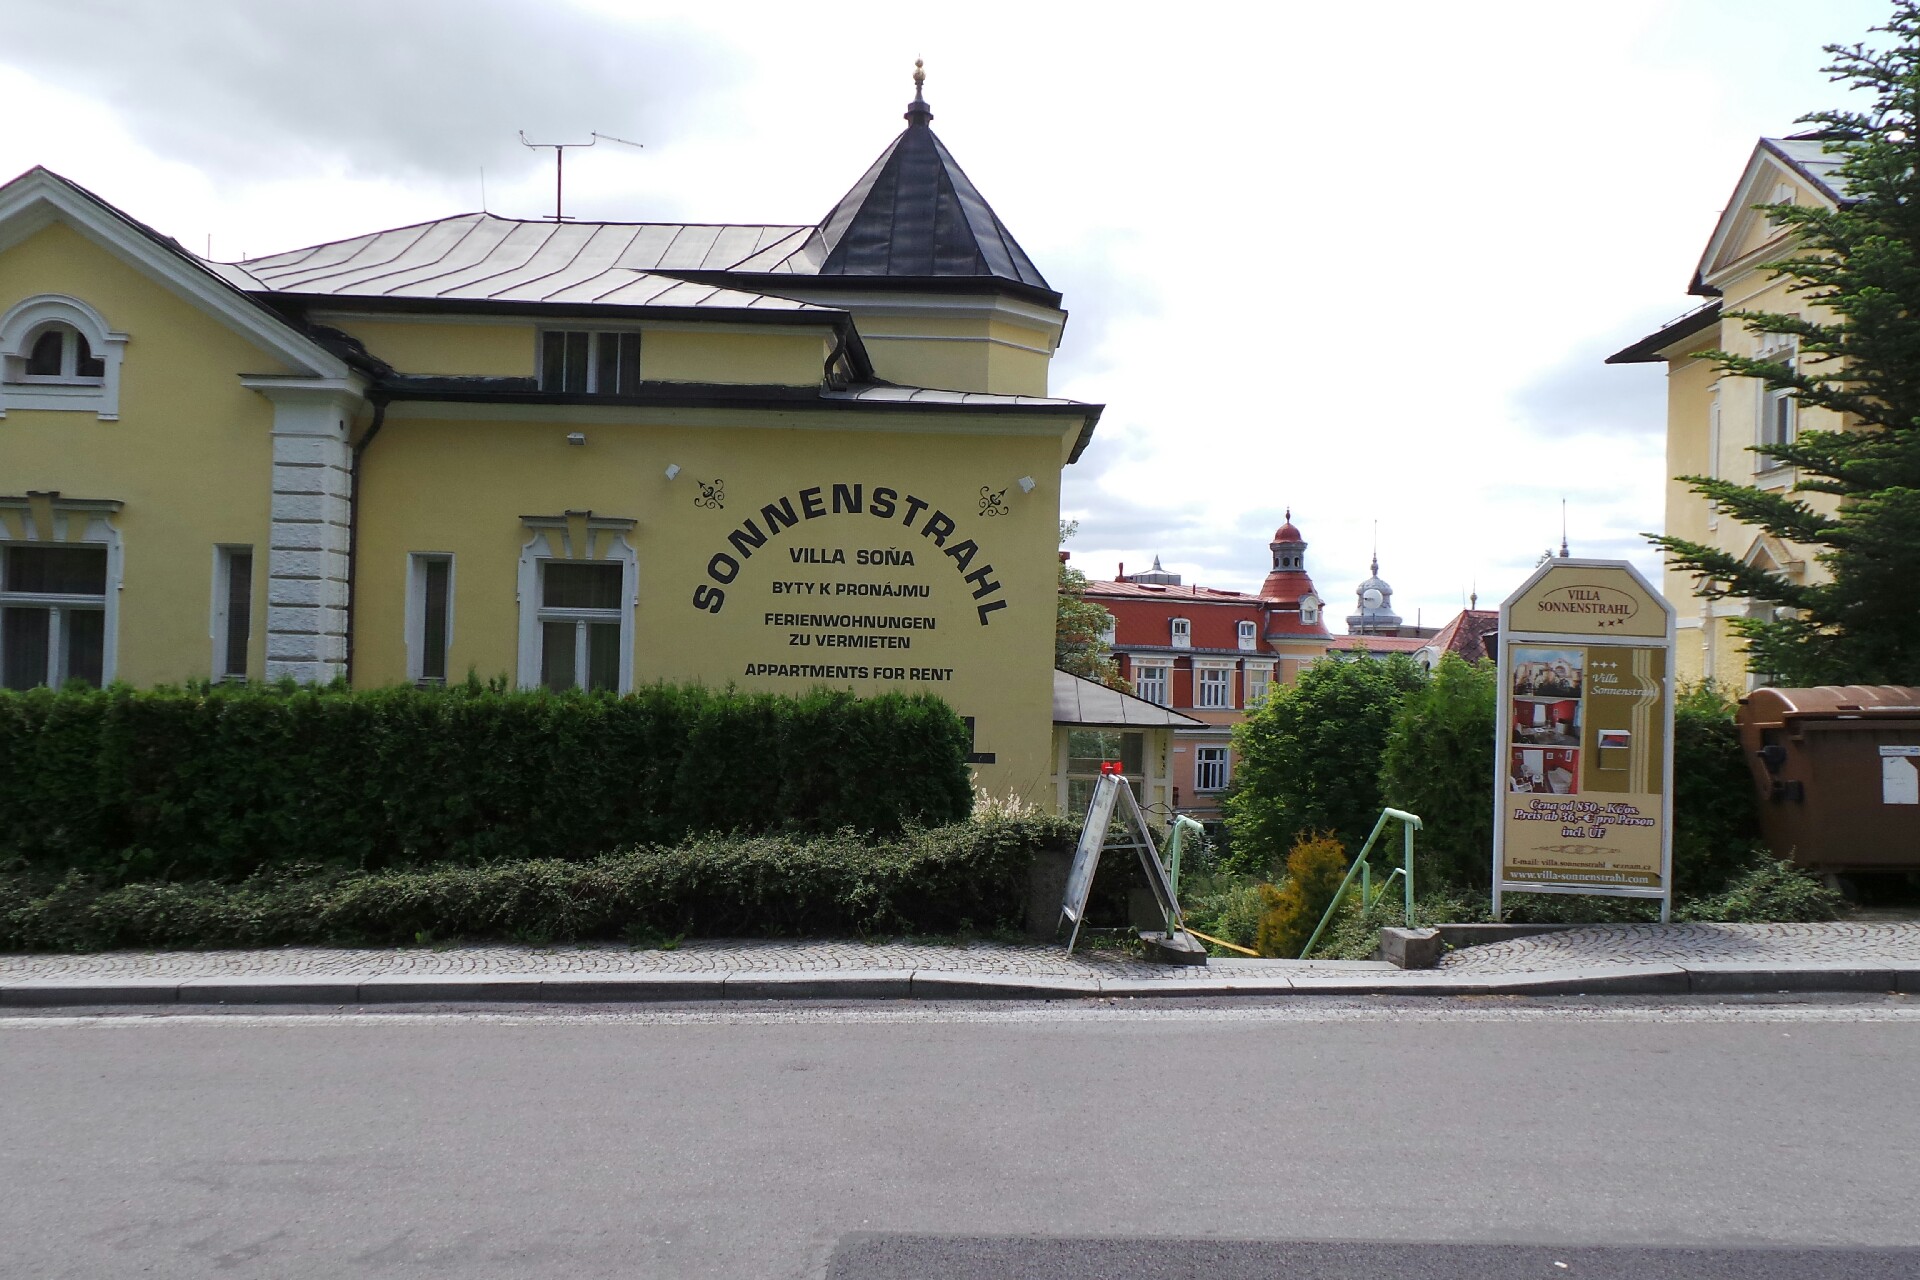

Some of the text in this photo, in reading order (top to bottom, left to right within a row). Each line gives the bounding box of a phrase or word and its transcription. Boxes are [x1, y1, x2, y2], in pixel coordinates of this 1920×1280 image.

[693, 484, 1007, 625] SONNENSTRAHL
[790, 546, 914, 566] VILLA SOŇA
[772, 582, 930, 598] BYTY K PRONÁJMU
[1568, 590, 1600, 600] VILLA
[1538, 602, 1630, 614] SONNENSTRAHL
[765, 613, 936, 630] FERIENWOHNUNGEN
[789, 634, 911, 649] ZU VERMIETEN
[745, 664, 953, 681] APPARTMENTS FOR RENT
[1592, 674, 1618, 684] Villa
[1530, 799, 1558, 810] Cena
[1560, 801, 1574, 811] od
[1514, 809, 1541, 820] Preis
[1544, 811, 1558, 821] ab
[1596, 816, 1615, 826] pro
[1617, 815, 1654, 826] Person
[1562, 825, 1606, 838] incl. ÜF
[1509, 871, 1649, 884] www.villa-sonnenstrahl.com
